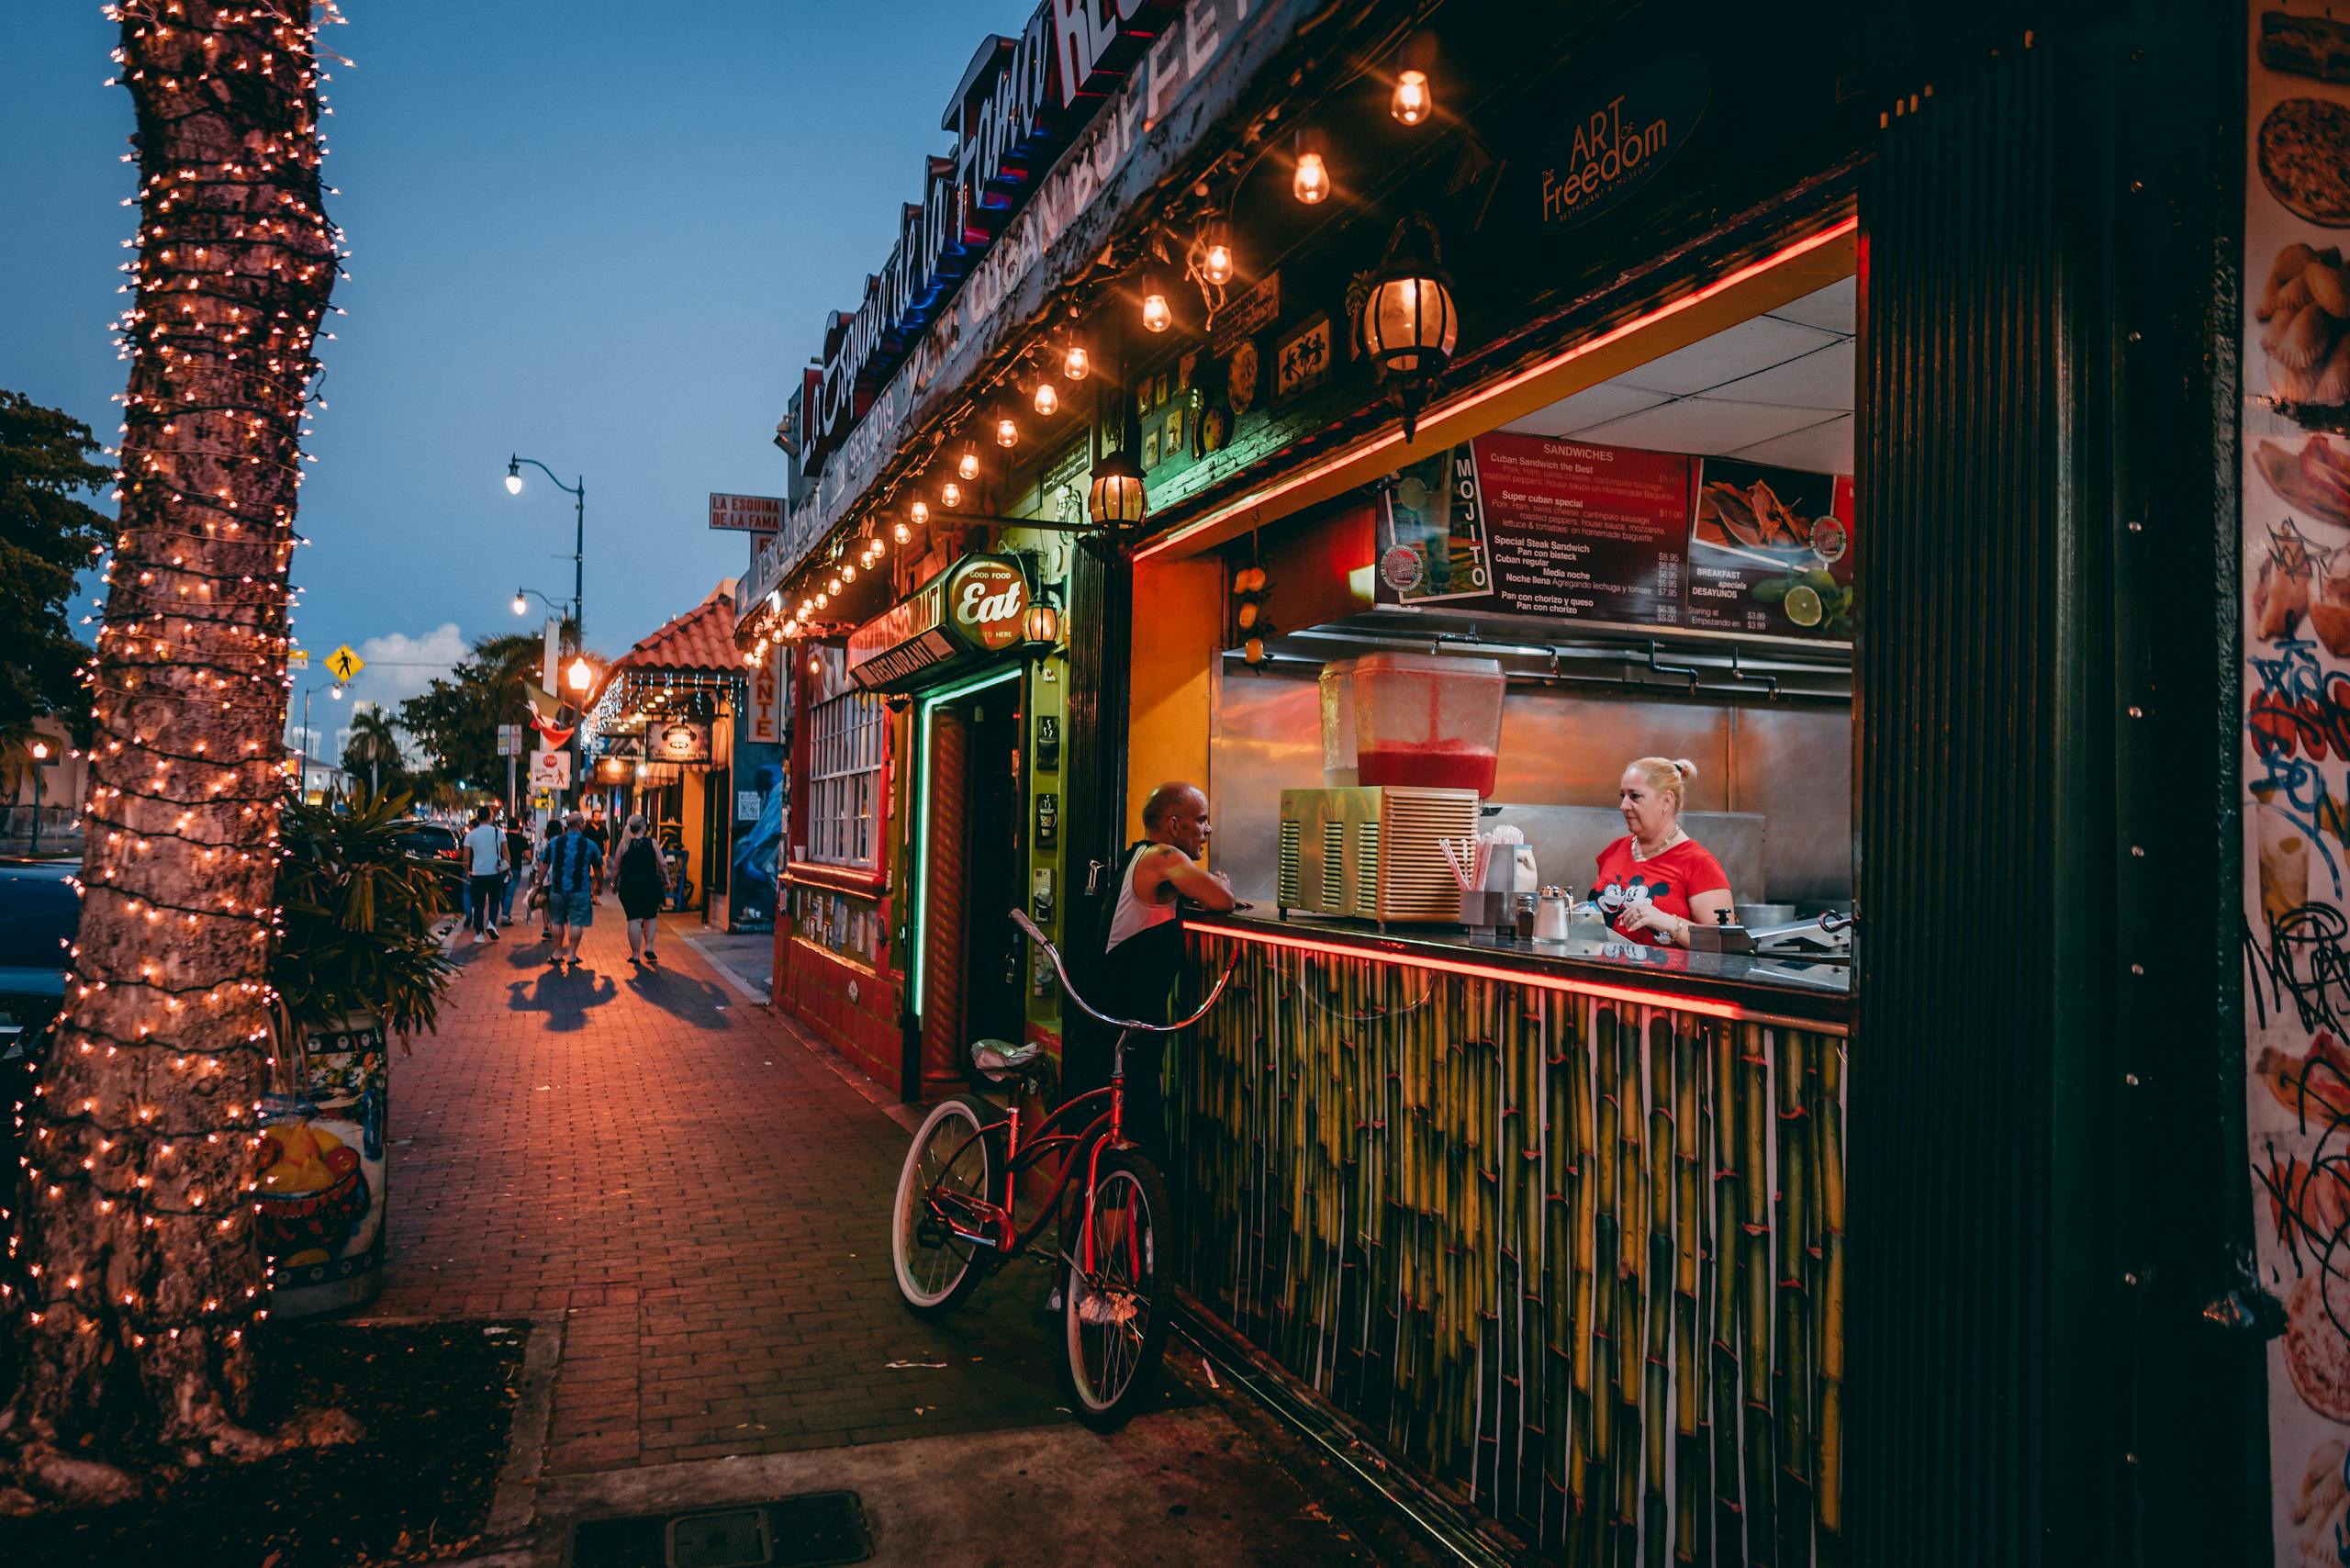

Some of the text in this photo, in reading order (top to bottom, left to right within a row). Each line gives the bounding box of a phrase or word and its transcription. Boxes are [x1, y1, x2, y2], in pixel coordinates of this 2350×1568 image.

[1070, 0, 1247, 216] BUFFE
[1570, 95, 1626, 174] ART
[1543, 118, 1667, 222] Freedom
[800, 367, 821, 477] La
[822, 309, 889, 437] Esquina
[894, 204, 916, 329] de
[923, 156, 948, 290] la
[942, 15, 1048, 244] Fama
[1544, 444, 1614, 462] SANDWICHES
[1491, 454, 1594, 475] Cuban Sandwich the Best
[1546, 478, 1567, 488] house
[1568, 484, 1590, 492] sauce
[1602, 486, 1643, 497] Homemade
[713, 496, 779, 512] LA ESQUINA
[1502, 490, 1583, 509] Super cuban special
[1533, 505, 1552, 513] swiss
[713, 512, 778, 529] DE LA FAMA
[1456, 459, 1486, 587] MOJITO
[1520, 512, 1547, 521] roasted
[1581, 518, 1603, 528] house
[1502, 519, 1527, 528] lettuce
[1528, 521, 1534, 530] &
[1535, 523, 1568, 533] tomatoes
[1582, 528, 1621, 539] homemade
[1622, 532, 1652, 543] baguette
[1494, 535, 1590, 554] Special Steak Sandwich
[1495, 554, 1550, 568] Cuban regular
[1517, 547, 1532, 557] Pan
[1550, 551, 1577, 562] bisteck
[1658, 552, 1679, 563] $8.95
[1658, 561, 1678, 571] $6.95
[1696, 567, 1740, 579] BREAKFAST
[969, 571, 1012, 580] GOOD FOOD
[1542, 567, 1591, 580] Media noche
[1658, 570, 1678, 580] $6.95
[1505, 573, 1531, 584] Noche
[1532, 576, 1551, 586] llena
[1552, 577, 1592, 590] Agregando
[1593, 582, 1621, 594] lechuga
[1628, 585, 1652, 595] tomate
[1658, 579, 1678, 589] $5.95
[1718, 580, 1747, 590] specials
[1501, 590, 1594, 608] Pan con chorizo y queso
[1658, 588, 1678, 598] $7.95
[1692, 587, 1738, 599] DESAYUNOS
[957, 580, 1021, 625] Eat
[1516, 601, 1578, 615] Pan con chorizo
[1658, 613, 1677, 623] $5.00
[1713, 609, 1719, 617] at
[1747, 611, 1766, 621] $3.99
[1692, 616, 1731, 627] Empezando
[1747, 621, 1766, 631] $3.99
[995, 631, 1013, 639] HERE
[867, 640, 935, 684] RESTAURANT
